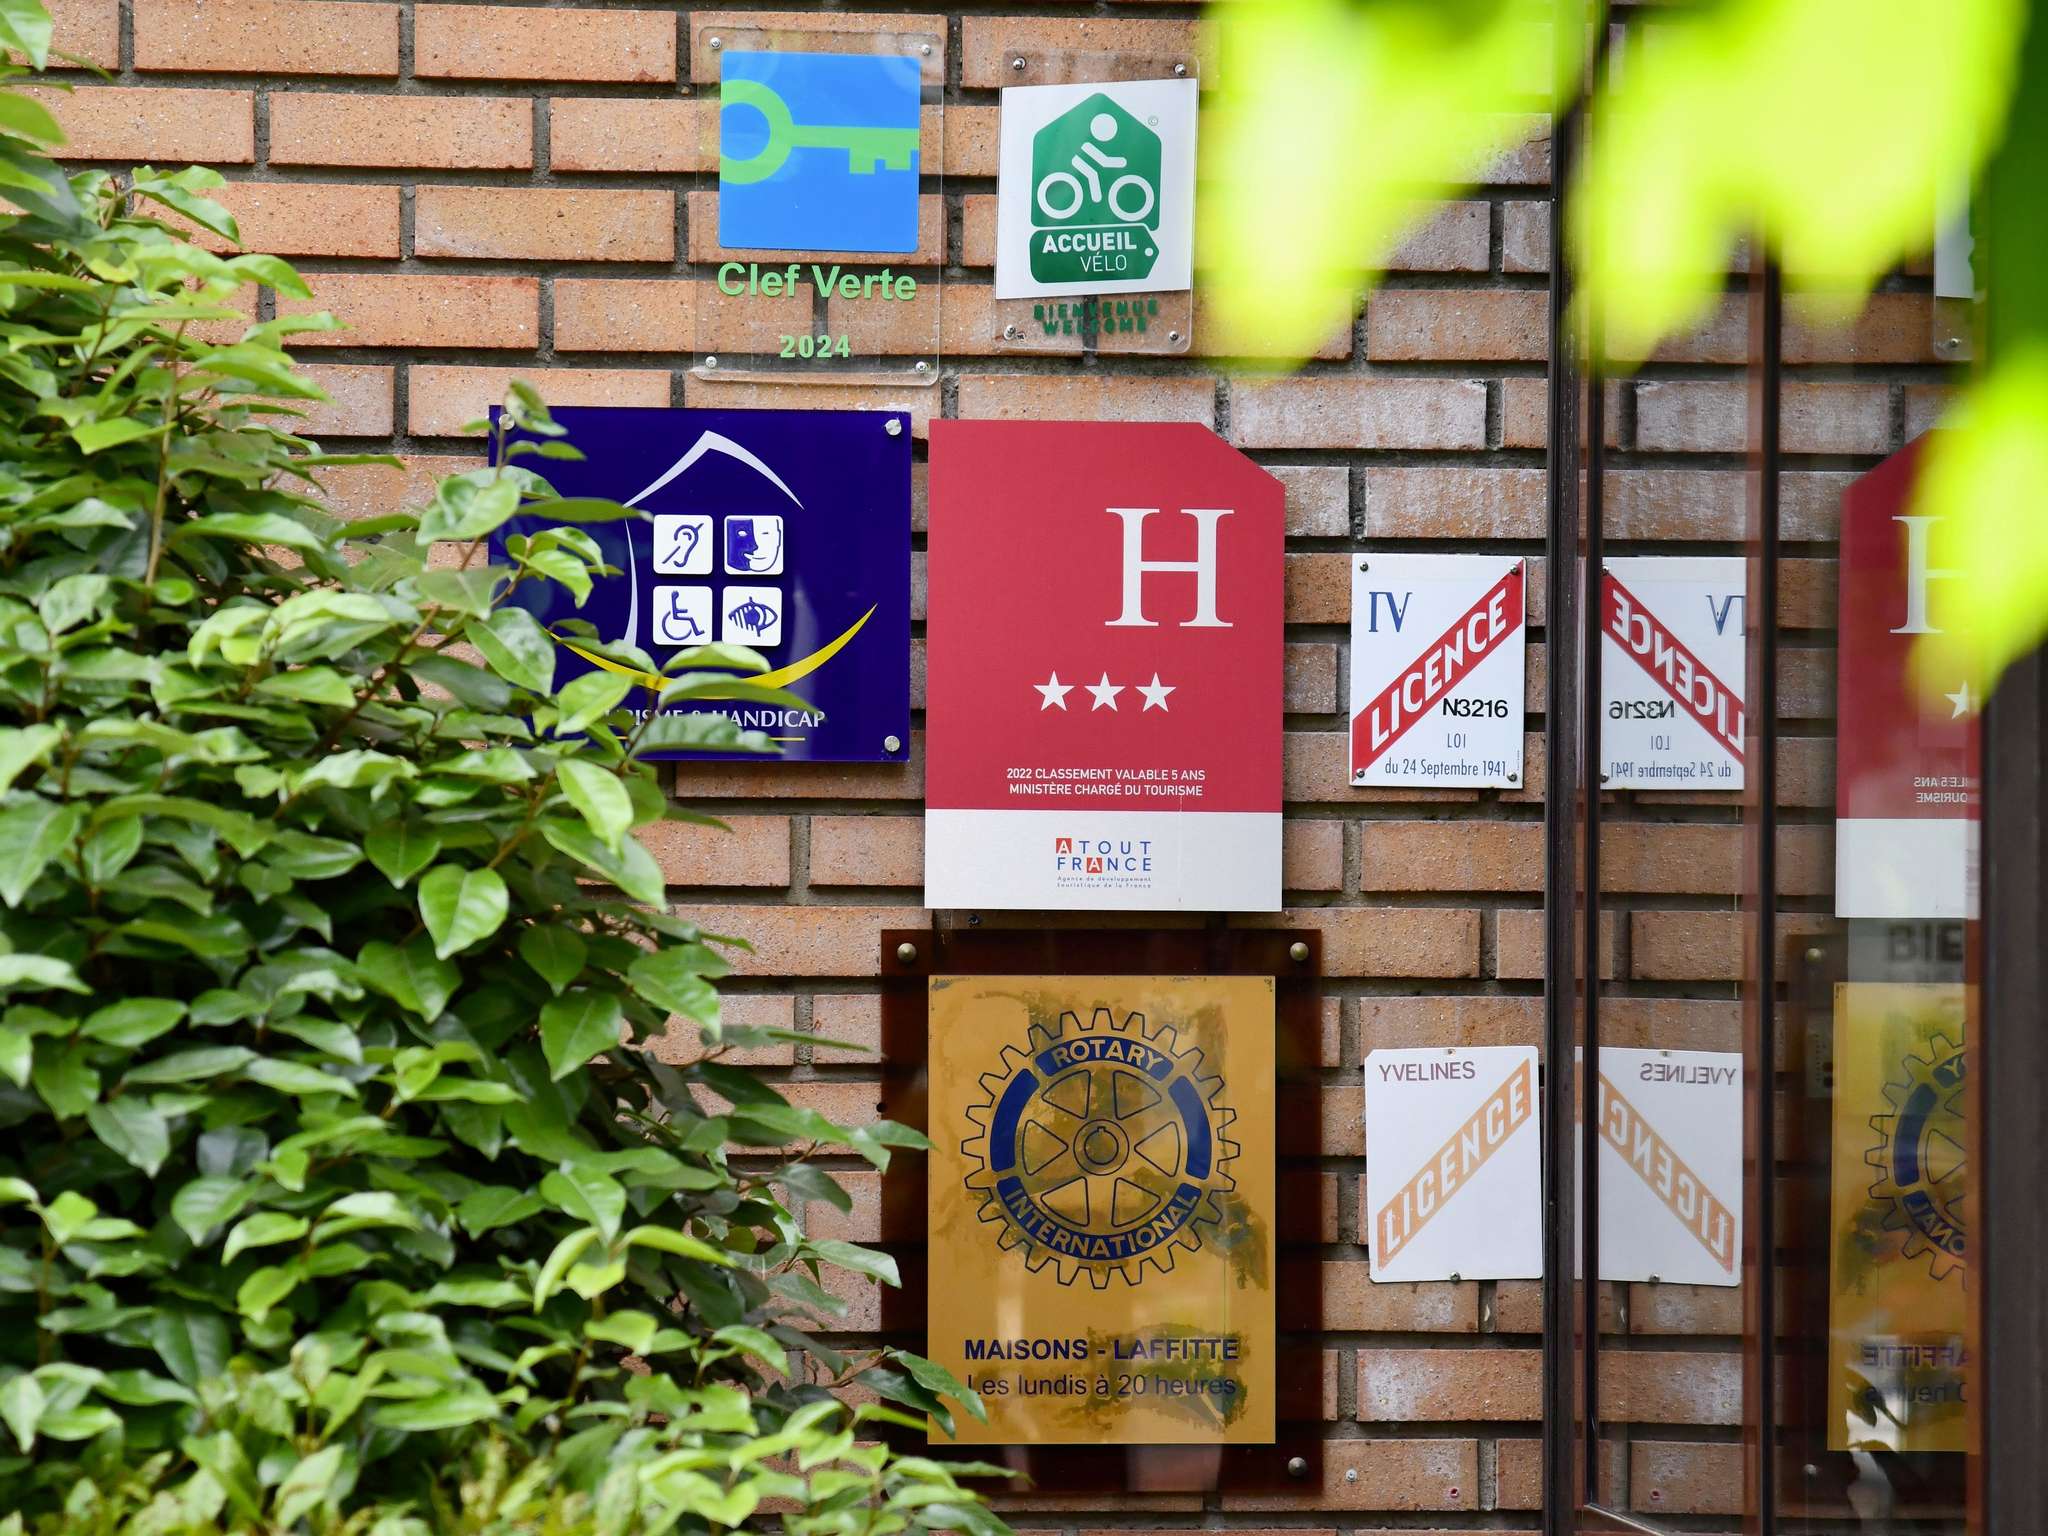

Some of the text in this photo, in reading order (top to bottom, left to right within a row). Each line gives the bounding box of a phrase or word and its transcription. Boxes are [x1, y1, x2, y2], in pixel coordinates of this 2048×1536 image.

[1042, 231, 1138, 254] ACCUEIL
[1080, 251, 1128, 272] VÉLO
[717, 262, 917, 301] Clef Verte
[779, 335, 851, 359] 2024
[1104, 507, 1235, 628] H
[1368, 591, 1413, 633] IV
[1371, 588, 1507, 752] LICENCE
[1442, 698, 1509, 718] N3216
[1447, 733, 1467, 749] LOI
[1006, 768, 1206, 781] 2022 CLASSEMENT VALABLE 5 ANS
[1384, 757, 1399, 775] du
[1402, 759, 1417, 774] 24
[1421, 758, 1479, 777] Septembre
[1482, 760, 1506, 776] 1941
[1009, 782, 1203, 796] MINISTÈRE CHARGÉ DU TOURISME
[1057, 857, 1152, 873] FRANCE
[1053, 1037, 1166, 1073] ROTARY
[1378, 1061, 1476, 1083] YVELINES
[1384, 1073, 1526, 1255] LICENCE
[1010, 1189, 1199, 1259] INTERNATIONAL
[964, 1339, 1089, 1361] MAISONS
[1114, 1339, 1239, 1361] LAFFITTE
[1018, 1374, 1087, 1395] lundis
[1095, 1374, 1110, 1396] à
[1118, 1374, 1147, 1396] 20
[1154, 1374, 1237, 1396] heures
